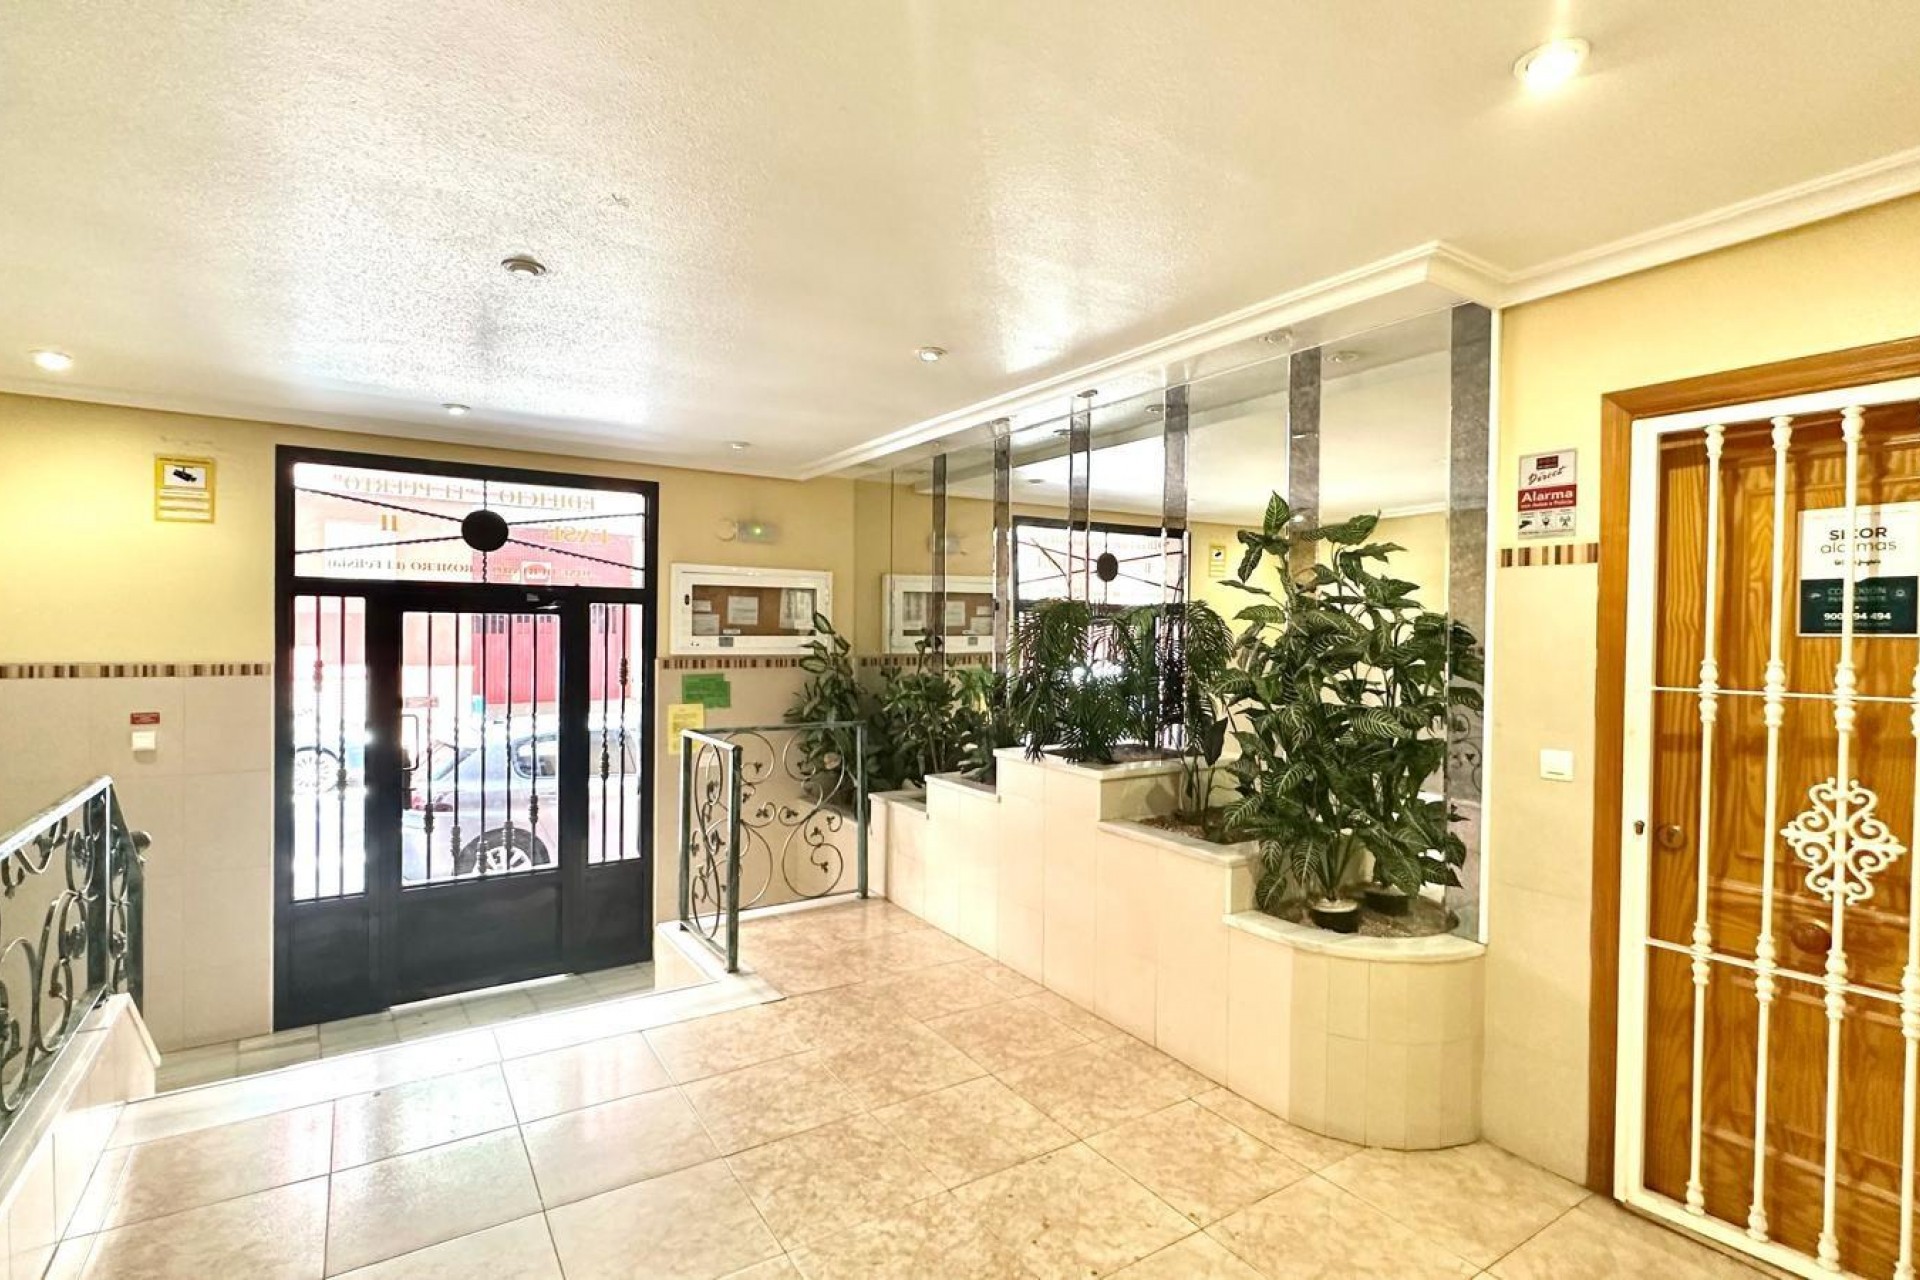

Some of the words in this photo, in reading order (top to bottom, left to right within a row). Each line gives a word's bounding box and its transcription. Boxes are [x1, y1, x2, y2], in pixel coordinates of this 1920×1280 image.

[1521, 490, 1573, 503] Alarma
[1829, 527, 1887, 541] SIOR
[1820, 541, 1897, 554] alamas
[1870, 612, 1892, 621] 494
